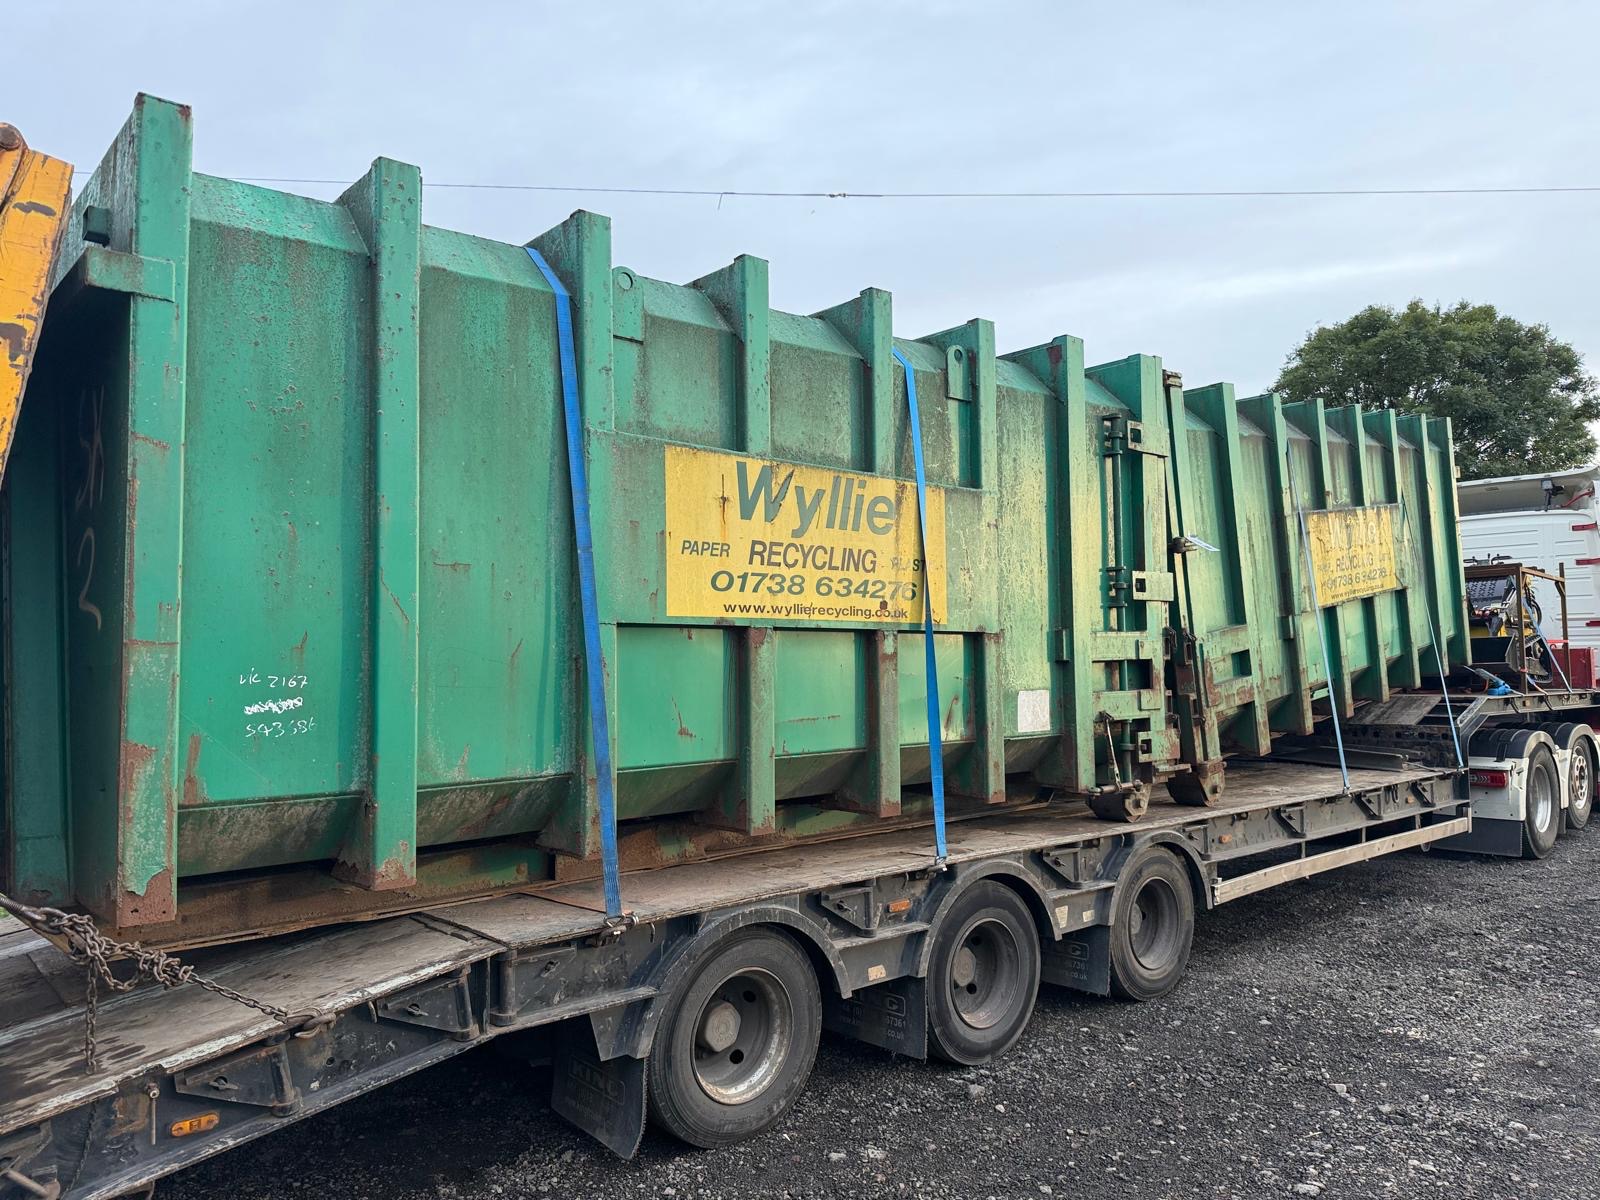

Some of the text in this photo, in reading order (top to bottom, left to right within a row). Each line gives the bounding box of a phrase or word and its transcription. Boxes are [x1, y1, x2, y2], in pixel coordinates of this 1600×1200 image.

[736, 461, 896, 538] Wyllie
[681, 540, 731, 557] PAPER
[748, 539, 877, 573] RECYCLING
[710, 570, 917, 601] 01738 634276
[723, 603, 908, 619] www.wyllierecycling.co.uk
[268, 675, 308, 688] 2167
